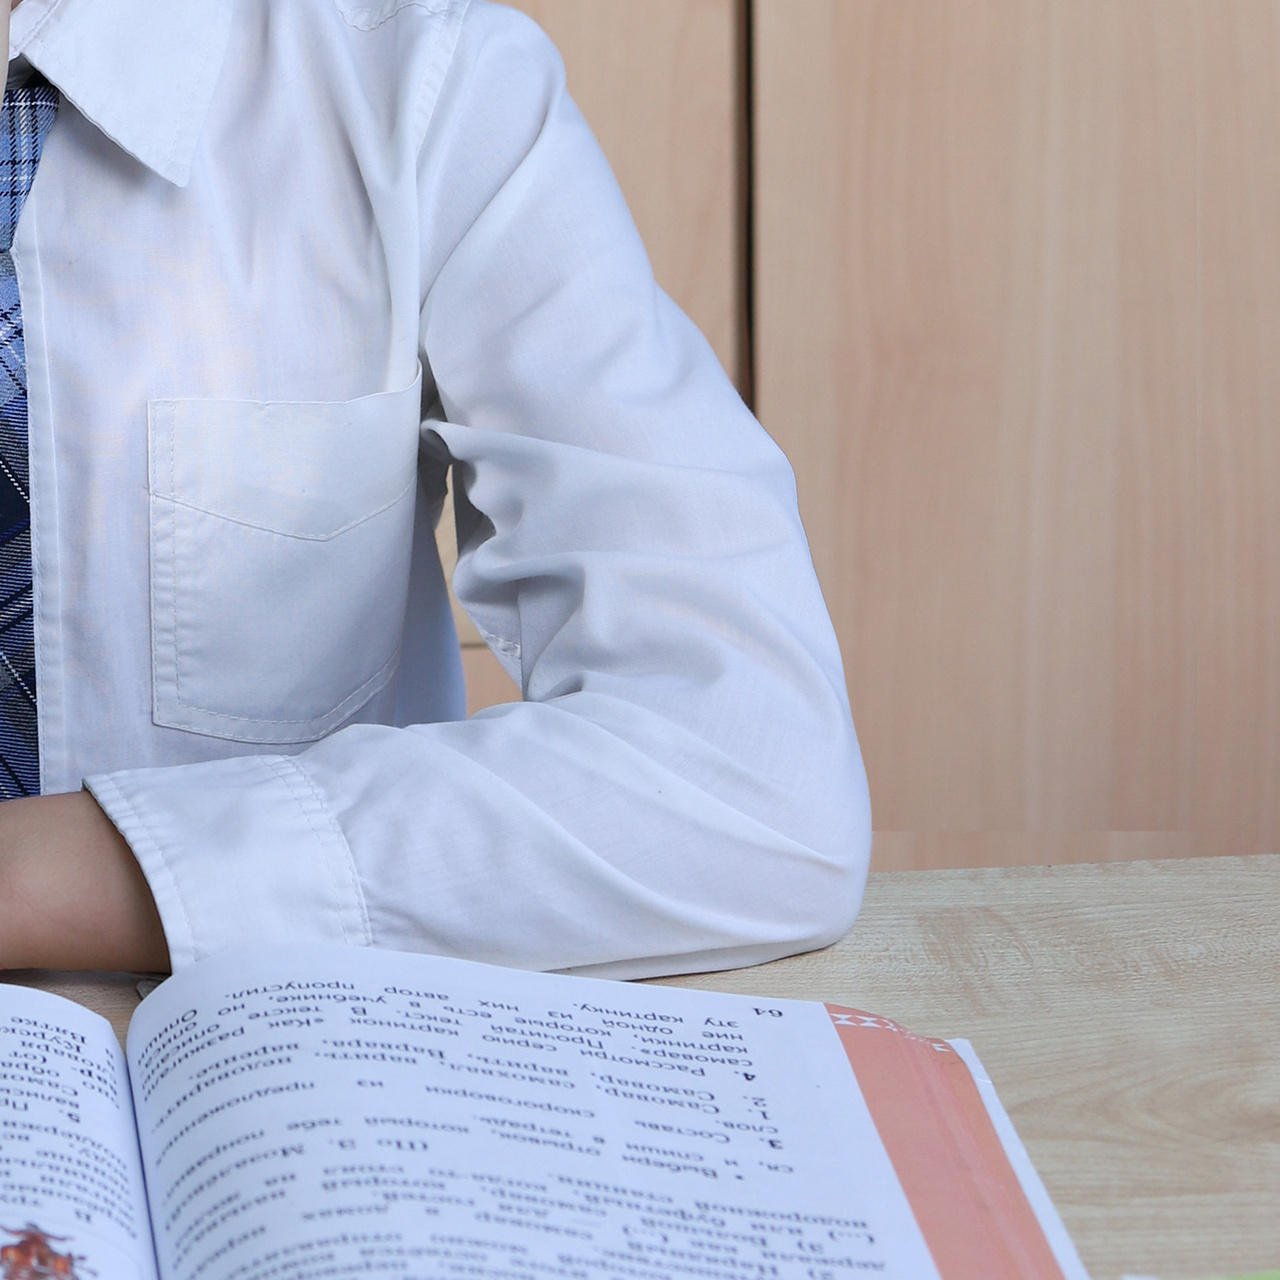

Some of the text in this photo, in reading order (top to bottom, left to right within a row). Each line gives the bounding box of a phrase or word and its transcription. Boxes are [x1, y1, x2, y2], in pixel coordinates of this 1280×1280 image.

[224, 980, 355, 1000] пропустил.
[383, 986, 449, 1001] автор
[268, 993, 388, 1005] учебнике,
[476, 999, 519, 1012] них
[217, 1003, 246, 1016] но
[247, 1005, 324, 1020] тексте
[350, 1006, 367, 1016] В
[395, 1009, 464, 1027] текст.
[443, 1005, 492, 1019] есть
[547, 1011, 573, 1020] из
[572, 1003, 739, 1028] эту картинку.
[751, 1007, 783, 1018] 64
[10, 1016, 88, 1046] Вятке
[267, 1018, 325, 1029] «Как
[349, 1017, 459, 1037] картинок
[514, 1017, 612, 1037] которые
[602, 1018, 673, 1035] одной
[481, 1034, 558, 1052] серию
[490, 1024, 604, 1050] Прочитай
[633, 1034, 748, 1054] картинки,
[701, 1031, 744, 1041] ние
[8, 1050, 47, 1064] (от
[20, 1040, 117, 1085] словаря
[314, 1051, 418, 1065] варить,
[579, 1049, 706, 1077] Рассмотри
[630, 1046, 753, 1067] самовар».
[188, 1039, 767, 1107] 2. Самовар, варить, Варвара, варенье.
[439, 1061, 576, 1089] самохвал,
[733, 1070, 757, 1081] 4.
[356, 1080, 384, 1088] из
[425, 1085, 596, 1118] скороговорки
[595, 1084, 720, 1115] Самовар,
[58, 1109, 81, 1124] 5.
[747, 1108, 772, 1121] 1.
[286, 1117, 342, 1132] тебе
[364, 1117, 469, 1134] который
[634, 1120, 731, 1144] Составь
[714, 1119, 779, 1134] слов.
[472, 1115, 794, 1174] ся, и спиши в тетрадь.
[490, 1128, 602, 1156] отрывок,
[758, 1137, 784, 1150] 3.
[323, 1163, 405, 1176] стоял
[621, 1154, 718, 1179] Выбери
[264, 1172, 297, 1187] на
[321, 1176, 446, 1191] который
[424, 1207, 440, 1216] в
[498, 1202, 549, 1219] для
[694, 1200, 868, 1229] нодорожной
[474, 1211, 593, 1241] самовар
[639, 1217, 768, 1248] Большой
[750, 1222, 803, 1236] или
